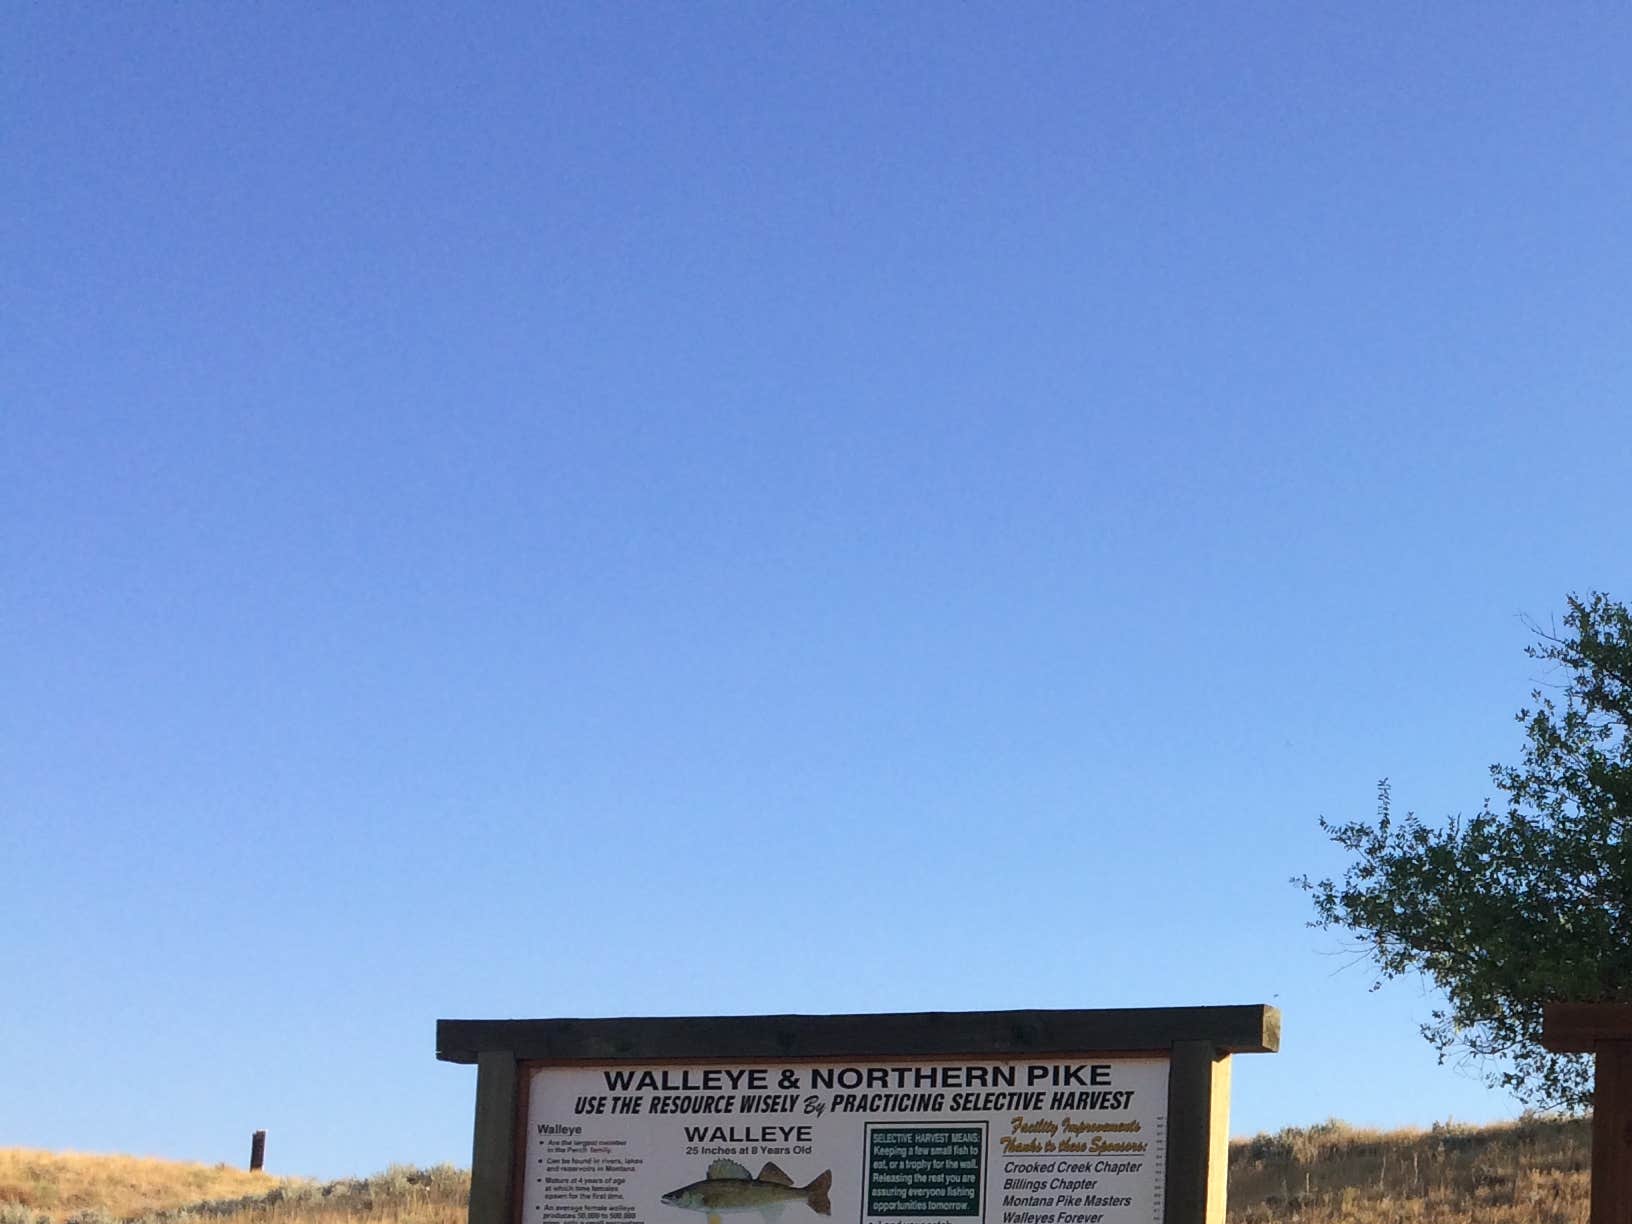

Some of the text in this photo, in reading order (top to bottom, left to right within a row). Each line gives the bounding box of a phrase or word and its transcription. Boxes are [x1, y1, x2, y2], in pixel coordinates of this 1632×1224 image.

[604, 1065, 1112, 1090] WALLEYE & NORTHERN PIKE
[574, 1091, 1134, 1118] USE THE RESOURCE WISELY By PRACTICING SELECTIVE HARVEST
[538, 1125, 582, 1136] Walleye
[1011, 1116, 1141, 1136] Facility Improvements
[684, 1126, 812, 1142] WALLEYE
[873, 1134, 912, 1143] SELECTIVE
[915, 1134, 948, 1143] HARVEST
[702, 1146, 736, 1155] Inches
[760, 1146, 790, 1154] Years
[793, 1146, 812, 1154] Old
[1000, 1137, 1042, 1153] Thanks
[1058, 1140, 1087, 1152] these
[1004, 1162, 1143, 1175] Crooked Creek Chapter
[1004, 1178, 1097, 1192] Billings Chapter
[1002, 1195, 1132, 1206] Montana Pike Masters
[1057, 1212, 1103, 1223] Forever
